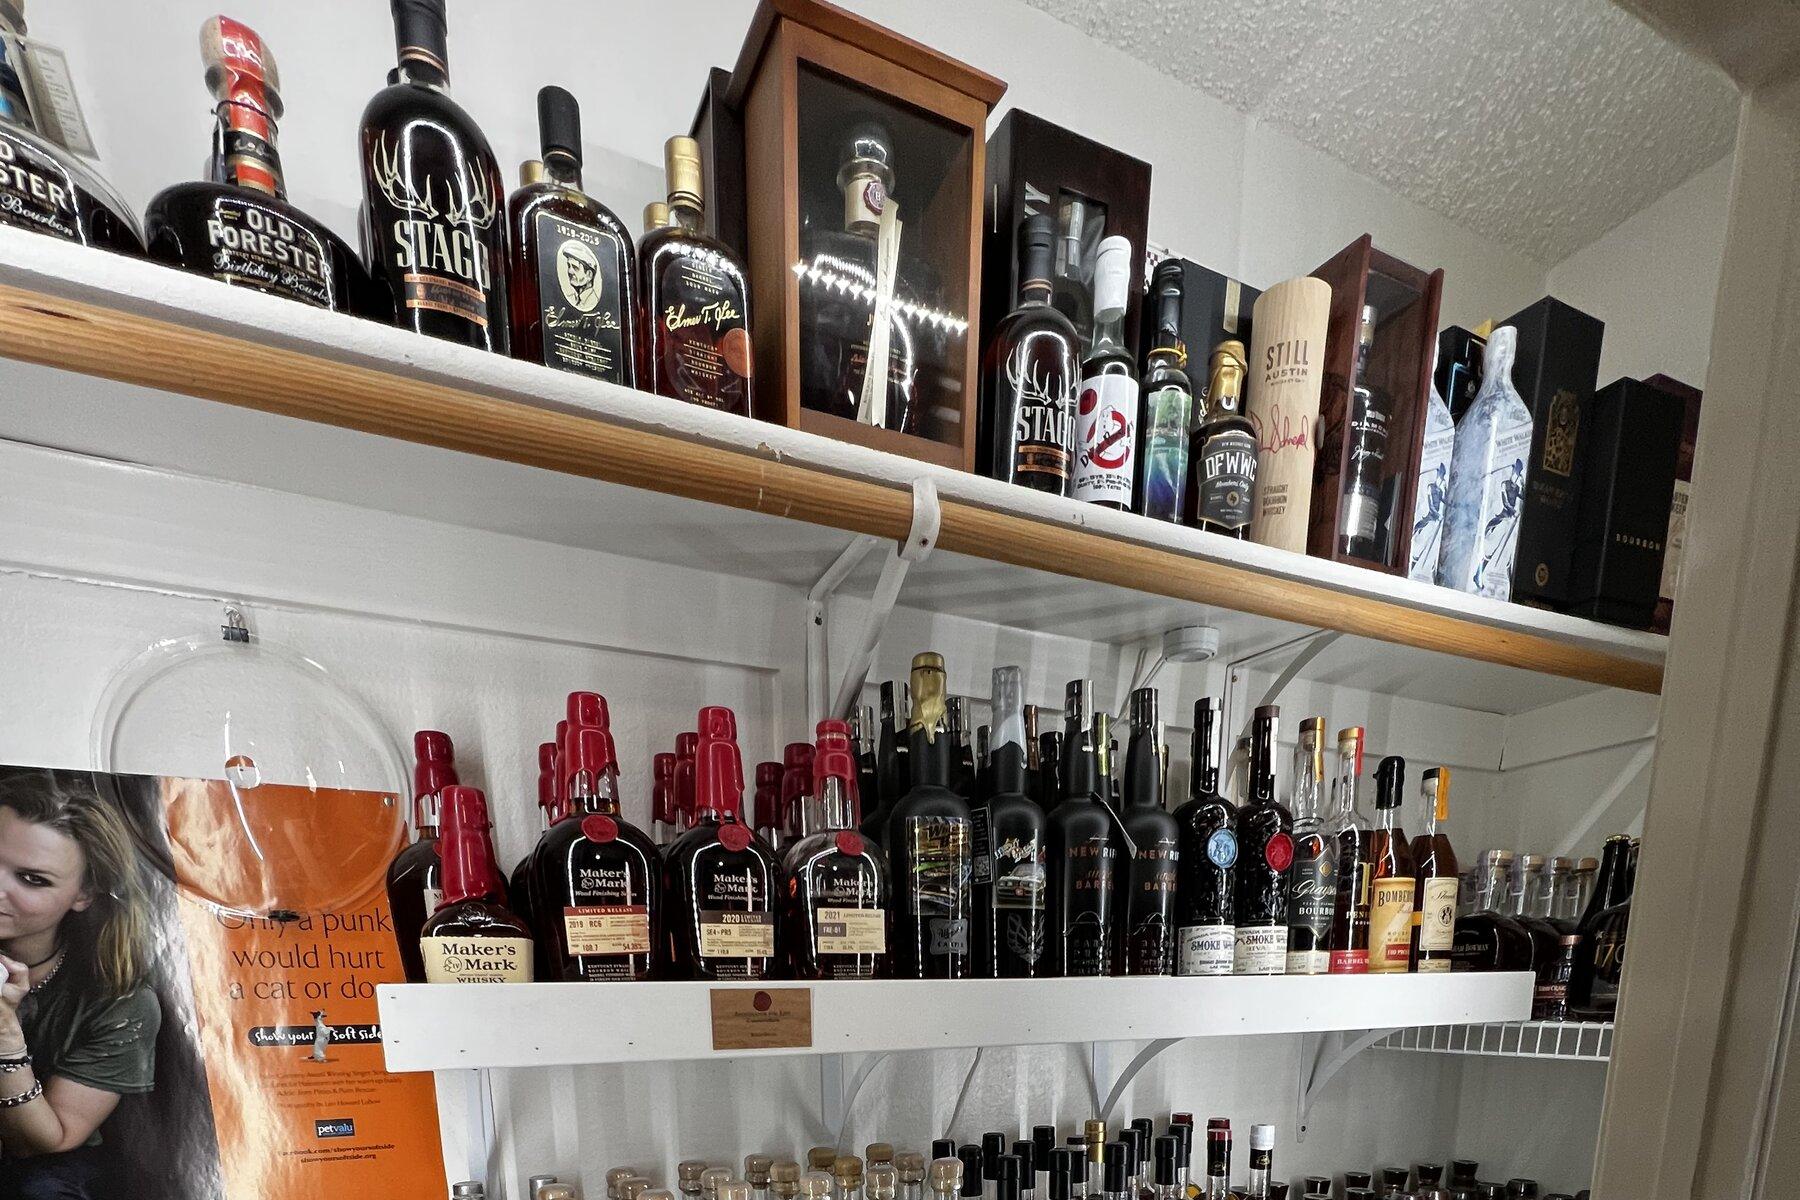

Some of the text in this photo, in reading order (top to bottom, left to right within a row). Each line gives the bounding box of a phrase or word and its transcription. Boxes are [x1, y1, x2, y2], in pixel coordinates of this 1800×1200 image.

[246, 208, 296, 241] OLD
[207, 219, 332, 284] FORESTER
[664, 304, 701, 331] Elmer
[1266, 340, 1309, 371] STILL
[1265, 368, 1308, 383] AUSTIN
[1068, 847, 1099, 858] NEW
[1139, 849, 1167, 859] NEW
[579, 869, 630, 878] Maker's
[714, 874, 758, 884] Make's
[595, 879, 627, 888] Mark
[722, 914, 740, 923] 2020
[824, 911, 840, 920] 2021
[322, 908, 392, 938] punk
[569, 920, 602, 929] 2019 RC6
[1191, 940, 1221, 952] SMOKE
[1246, 935, 1274, 946] SMOKE
[442, 943, 516, 956] Maker's
[232, 944, 385, 969] would hurt
[465, 959, 516, 971] Mark
[229, 974, 375, 1000] a cat or do
[254, 1028, 286, 1042] show
[288, 1032, 315, 1045] your
[332, 1026, 357, 1041] soft
[317, 1124, 353, 1136] petvalu
